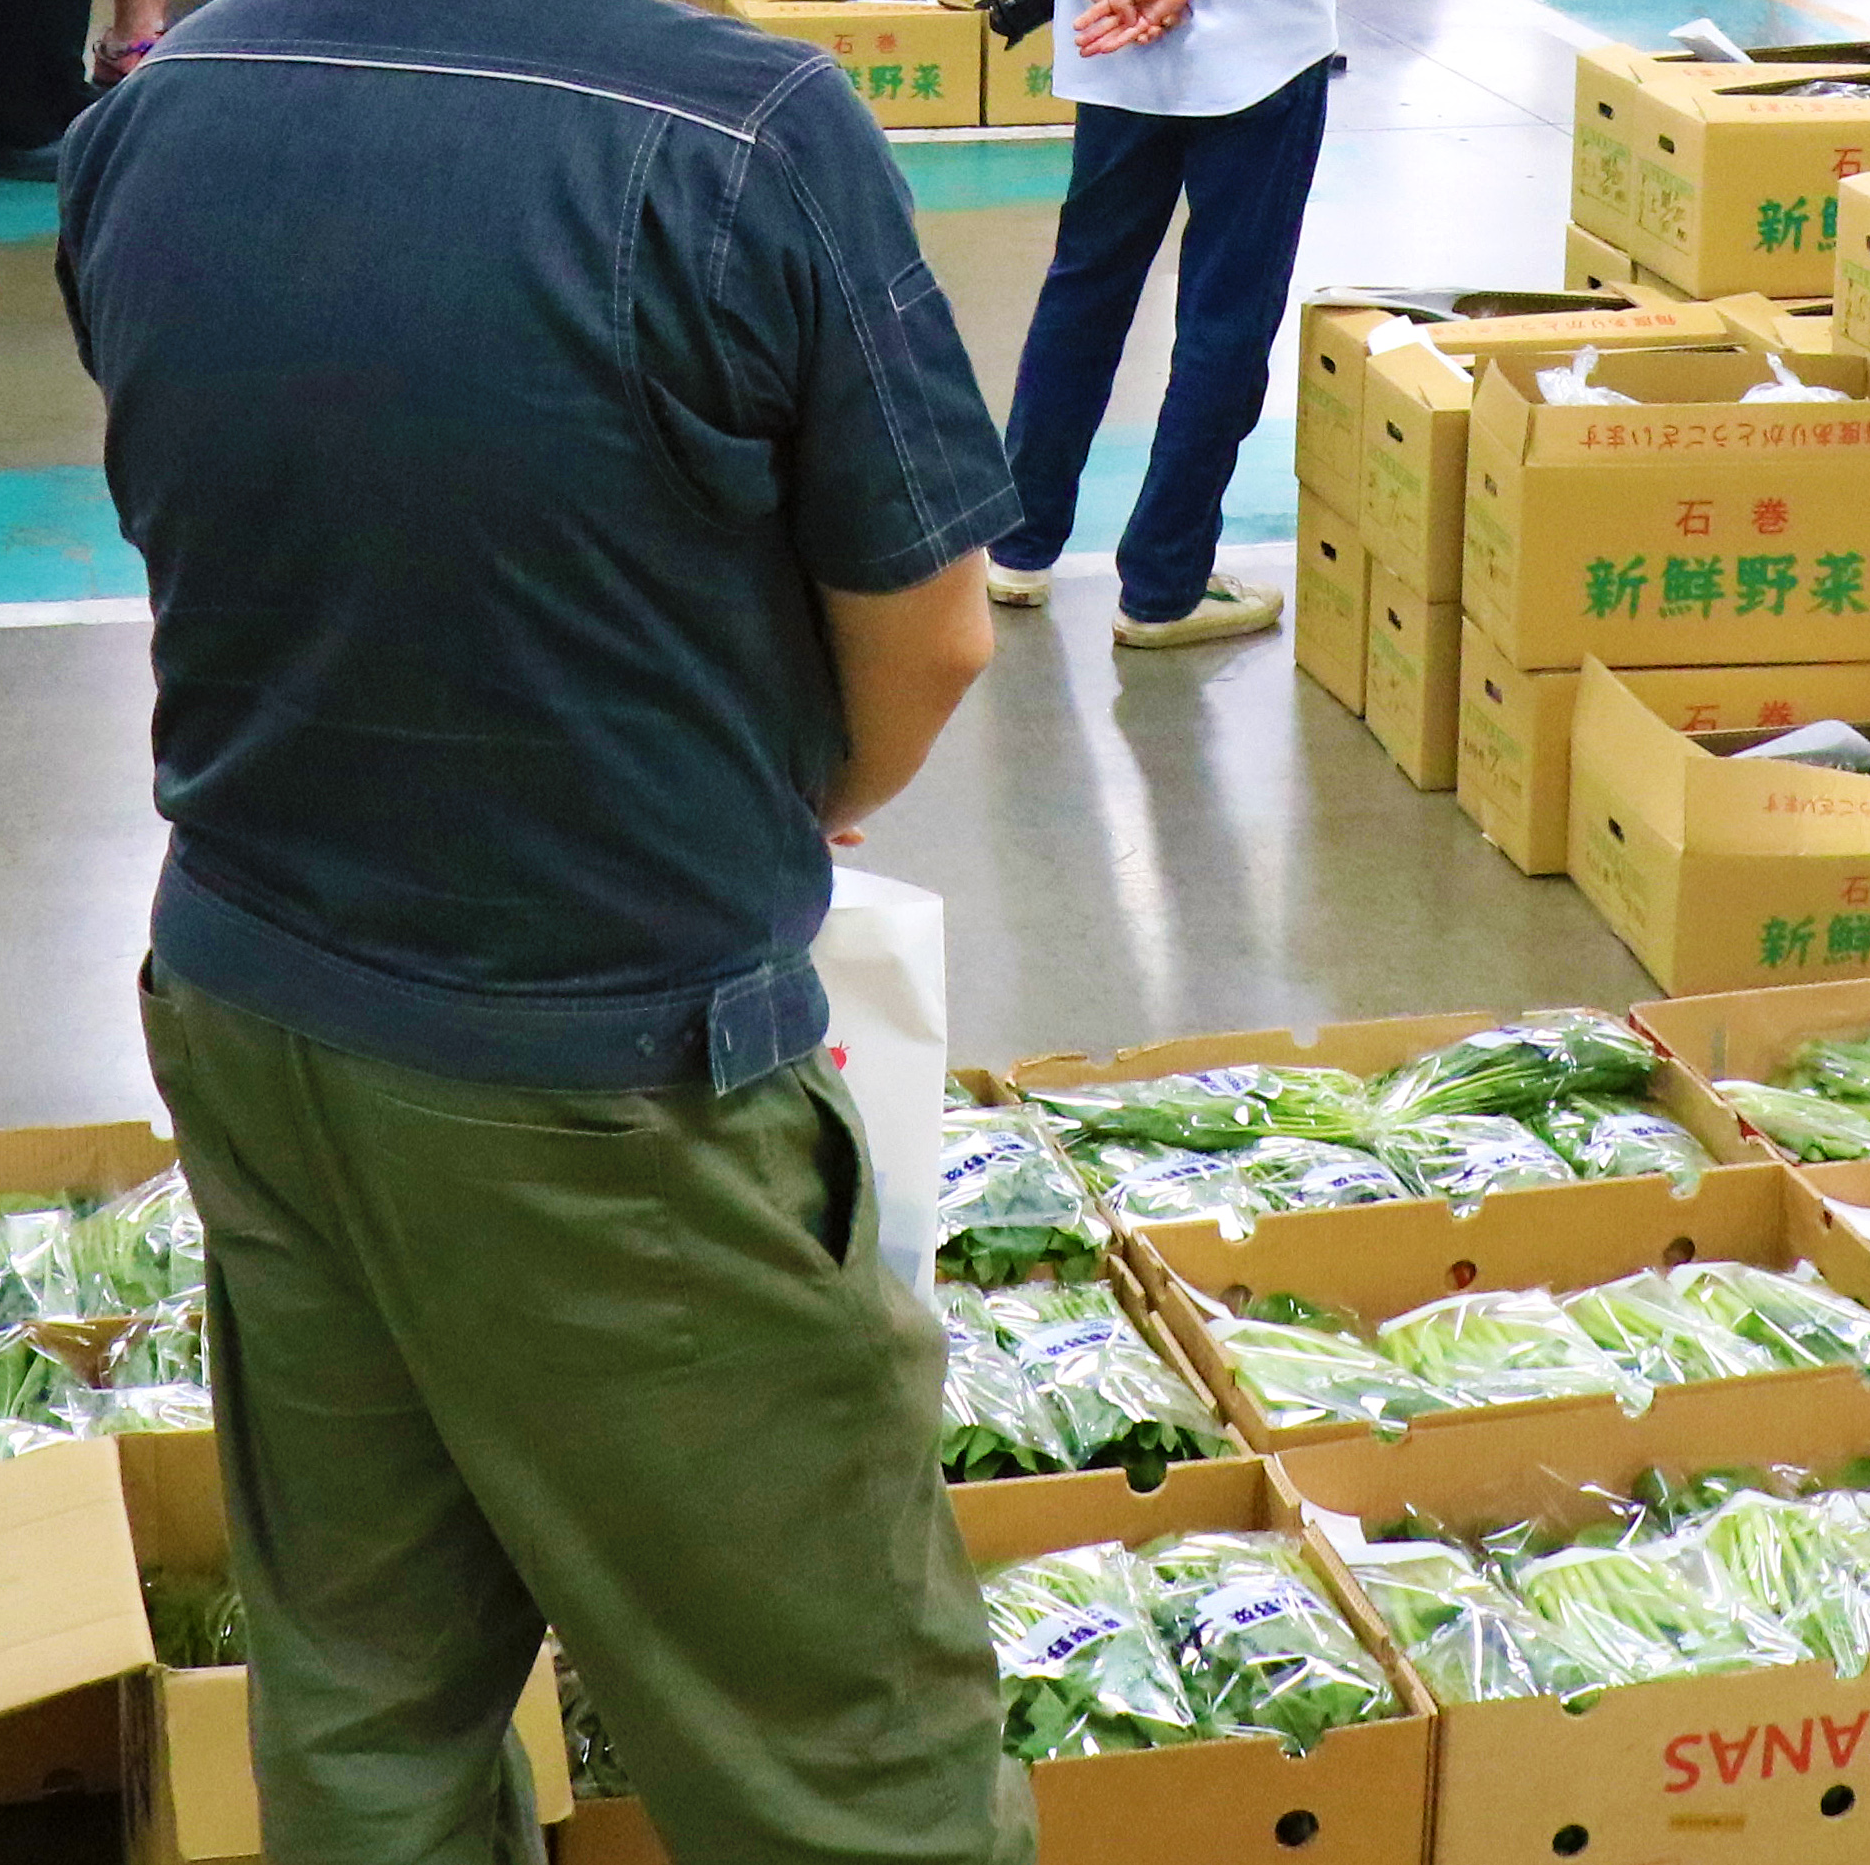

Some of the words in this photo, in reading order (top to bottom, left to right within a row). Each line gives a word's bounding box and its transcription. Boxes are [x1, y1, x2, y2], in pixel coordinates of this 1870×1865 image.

[833, 32, 898, 56] 石巻
[1675, 496, 1792, 538] 石巻
[1581, 549, 1870, 620] 新鮮野菜
